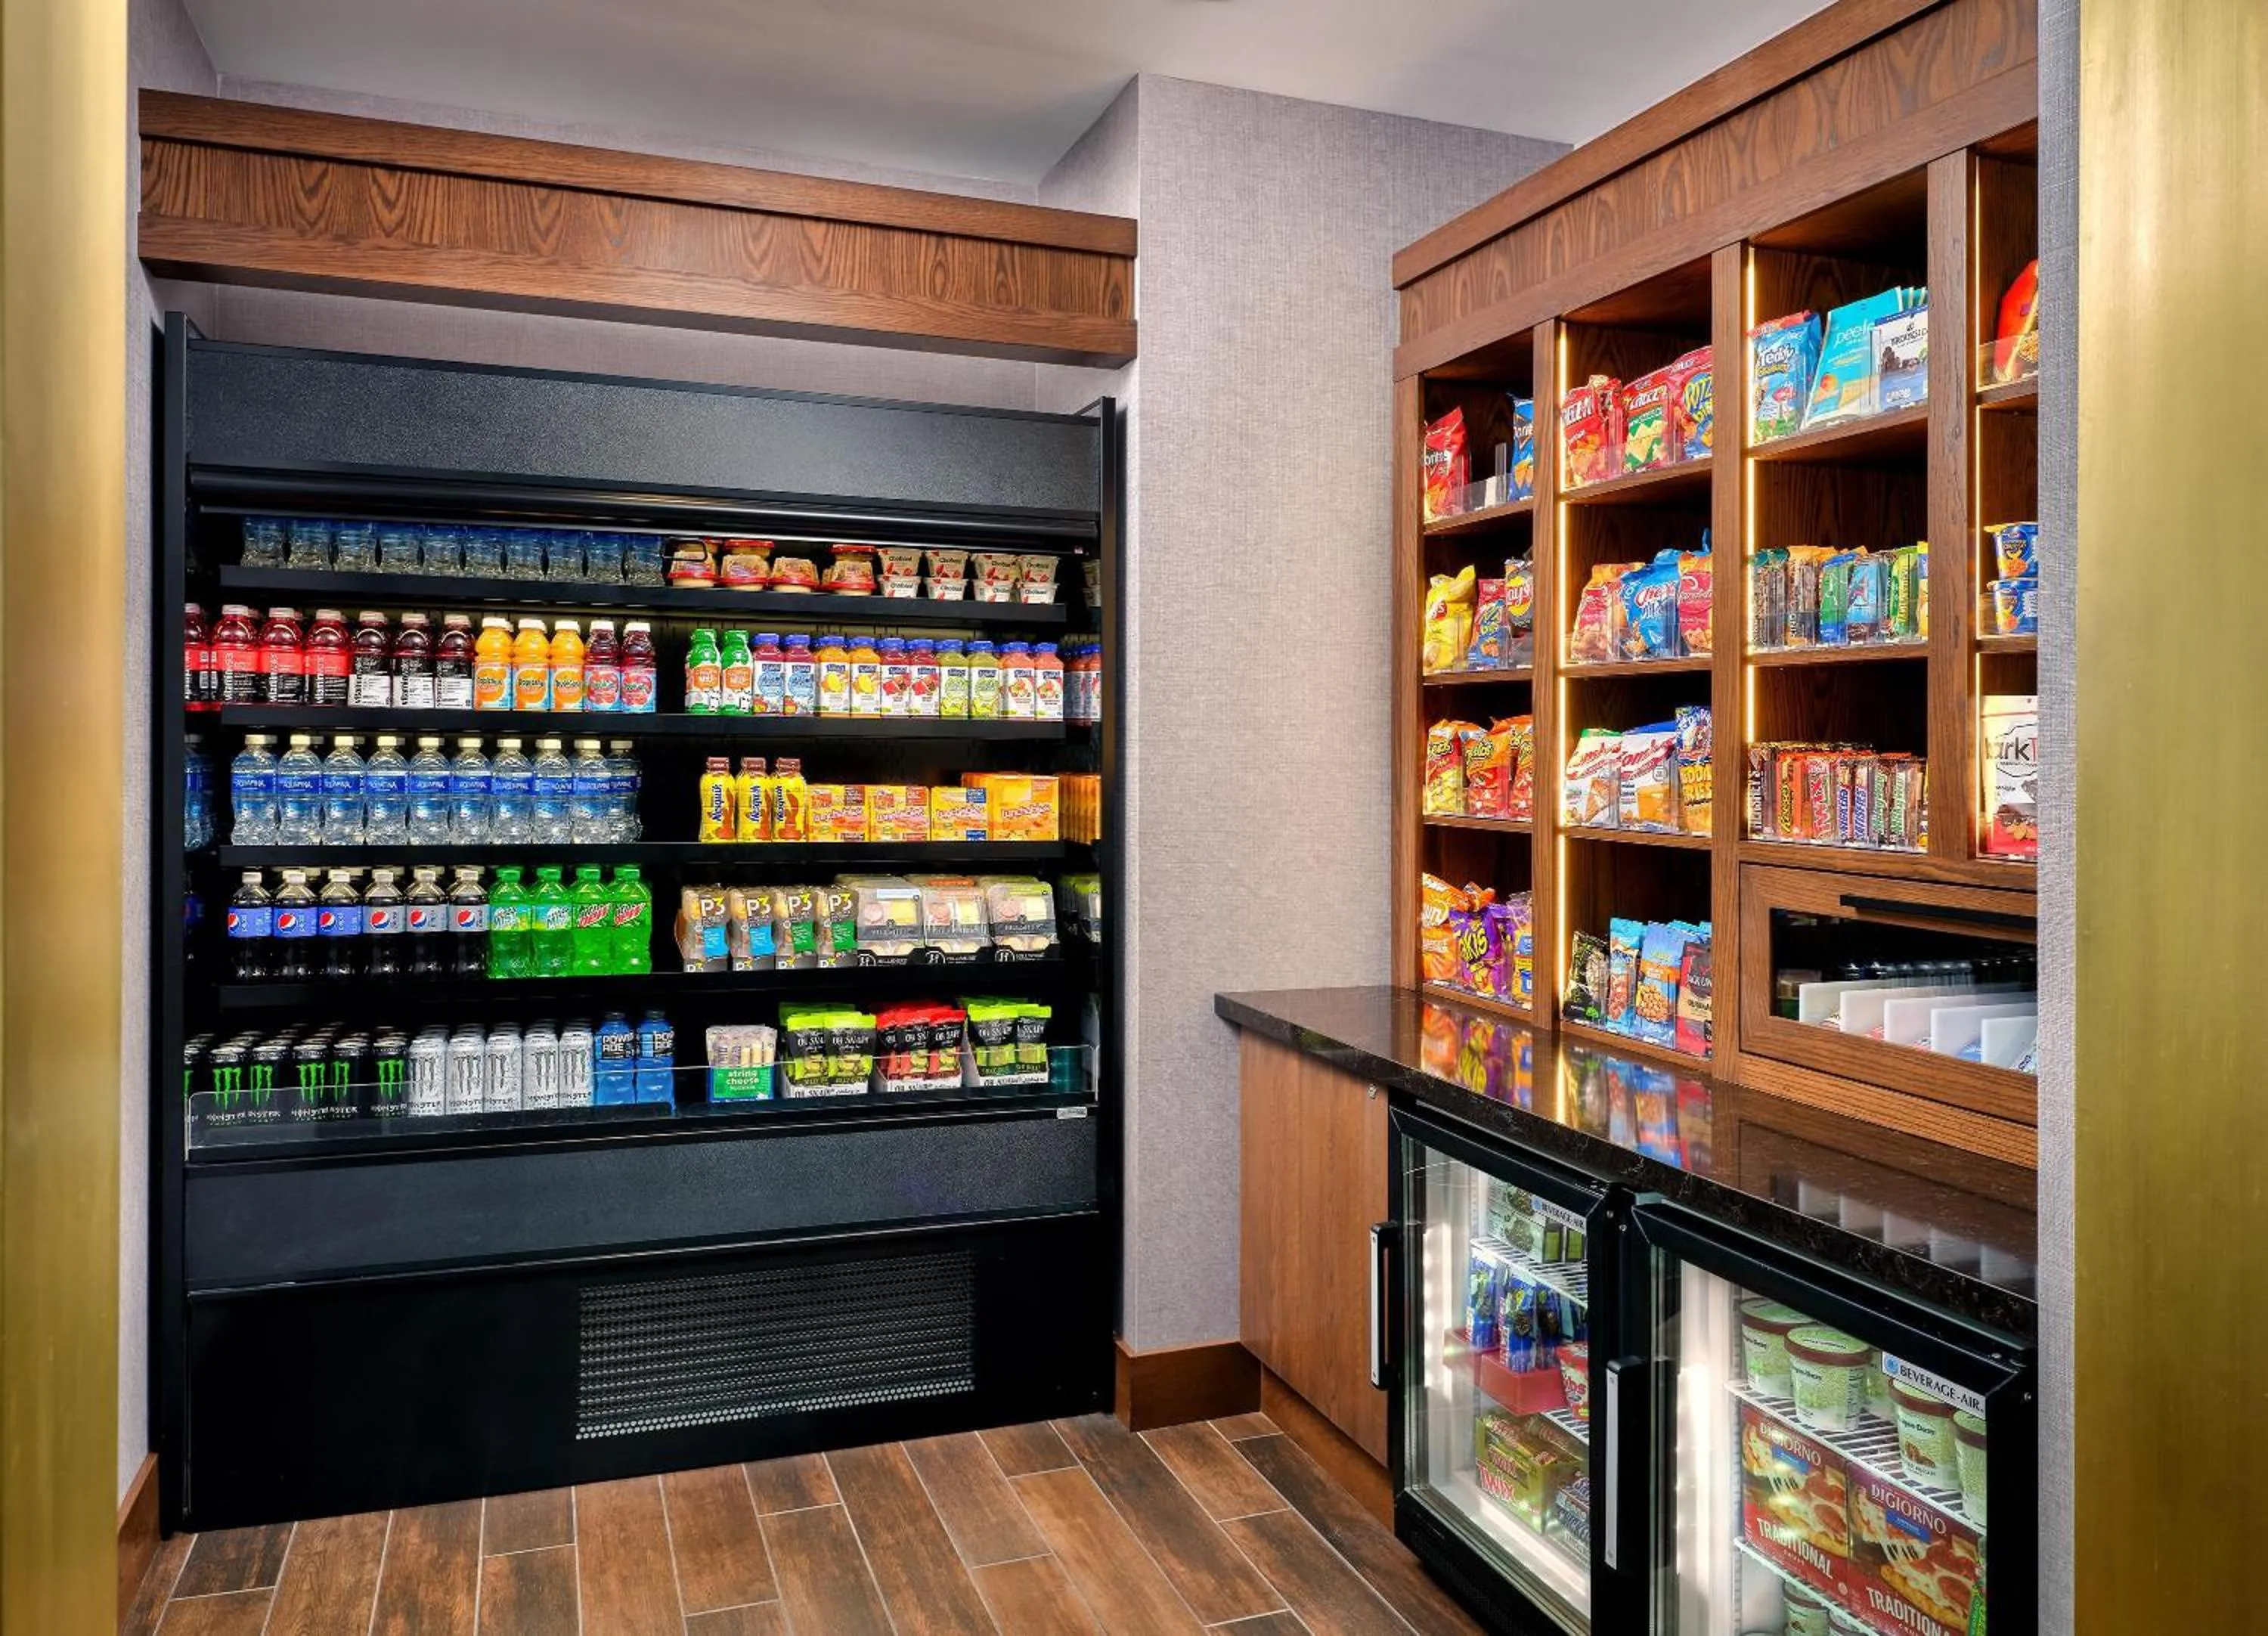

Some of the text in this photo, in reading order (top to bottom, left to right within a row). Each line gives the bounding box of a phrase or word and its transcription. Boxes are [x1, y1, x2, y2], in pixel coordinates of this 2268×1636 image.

[701, 895, 726, 916] P3
[747, 894, 772, 916] P3
[788, 892, 813, 915] P3
[829, 893, 853, 916] P3
[728, 1070, 758, 1078] string
[1759, 1421, 1821, 1467] DIIORNO
[1870, 1484, 1947, 1535] DIGIORNO
